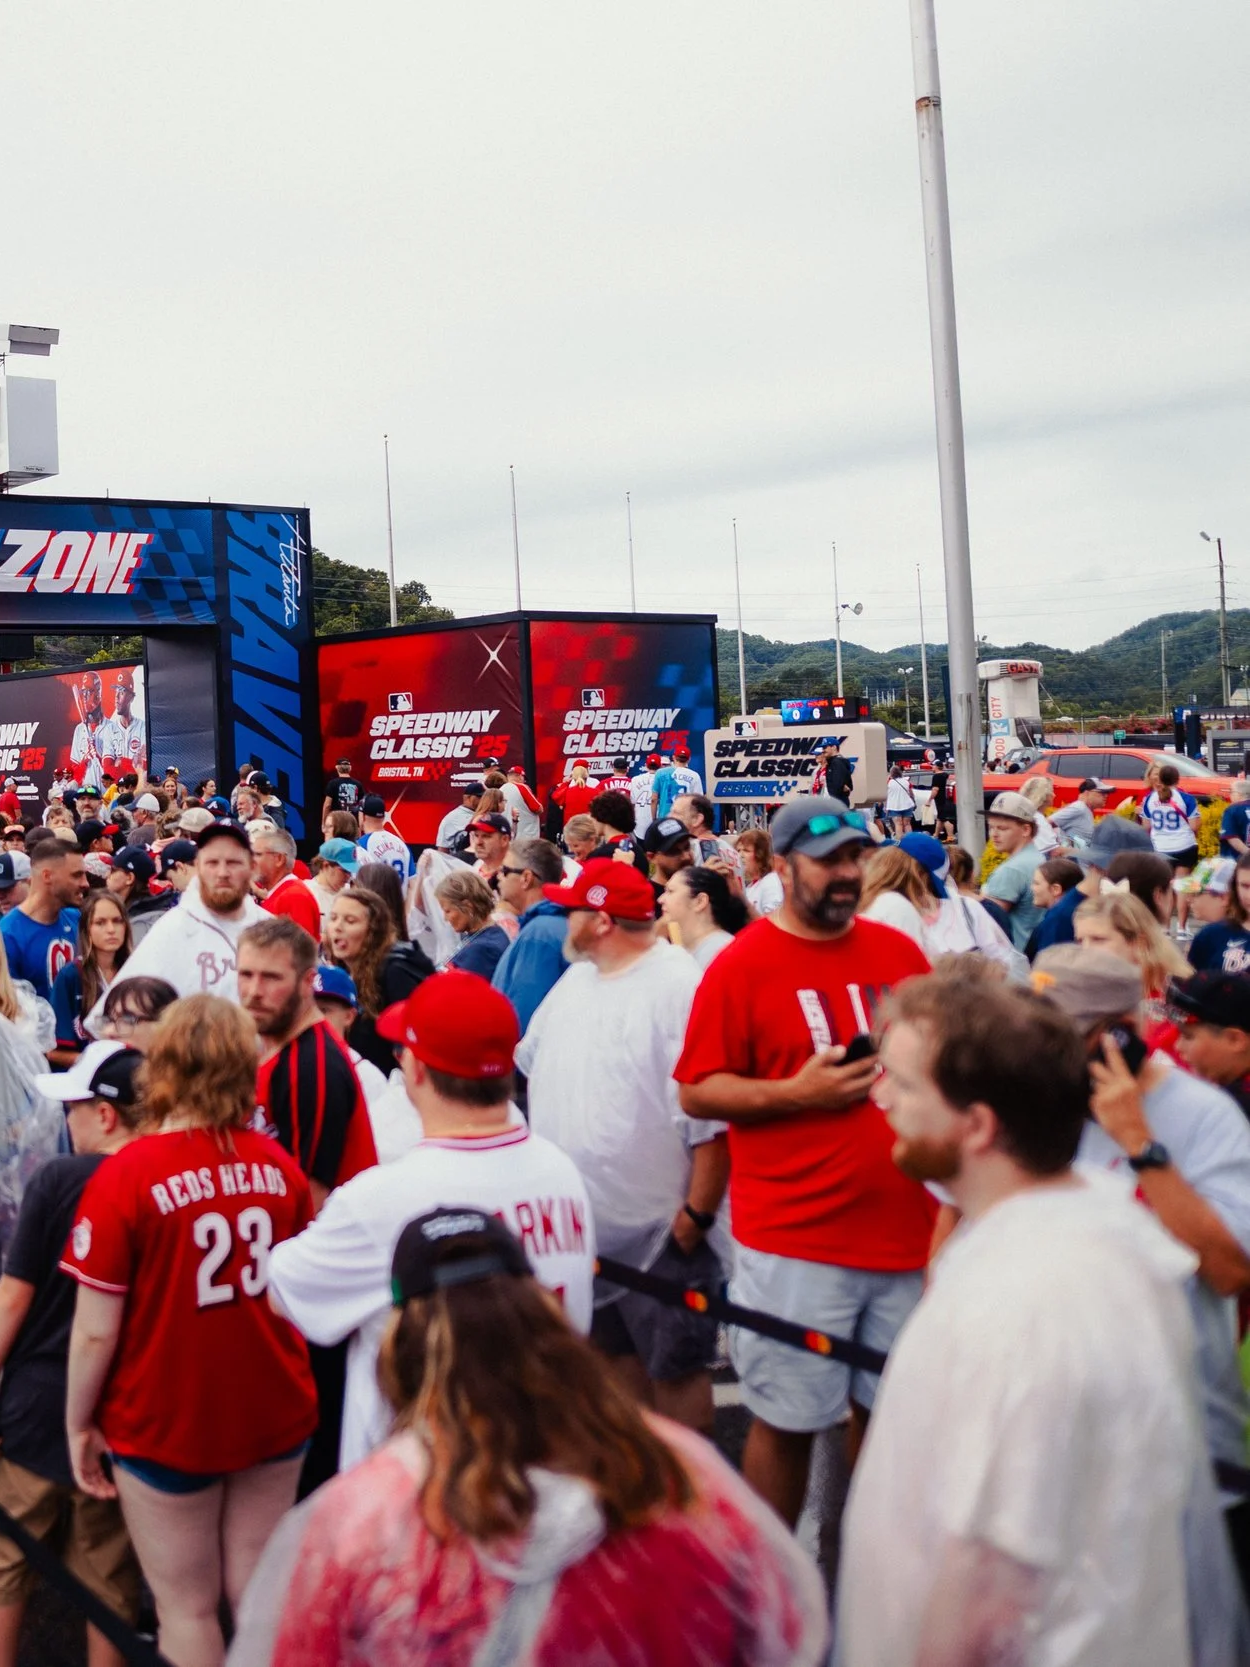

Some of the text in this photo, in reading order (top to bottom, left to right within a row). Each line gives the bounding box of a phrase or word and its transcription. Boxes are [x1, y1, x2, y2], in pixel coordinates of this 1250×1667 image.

[226, 510, 305, 840] BRAVE
[812, 708, 821, 719] 6
[991, 697, 1002, 718] CITY
[369, 709, 501, 737] SPEEDWAY
[562, 708, 682, 732] SPEEDWAY
[369, 735, 511, 760] CLASSIC '25
[562, 731, 659, 755] CLASSIC
[20, 747, 47, 770] '25
[714, 758, 819, 778] CLASSIC
[378, 766, 425, 779] BRISTOL, TN
[1152, 809, 1180, 831] 99
[151, 1162, 287, 1215] REDS HEADS
[193, 1205, 273, 1308] 23
